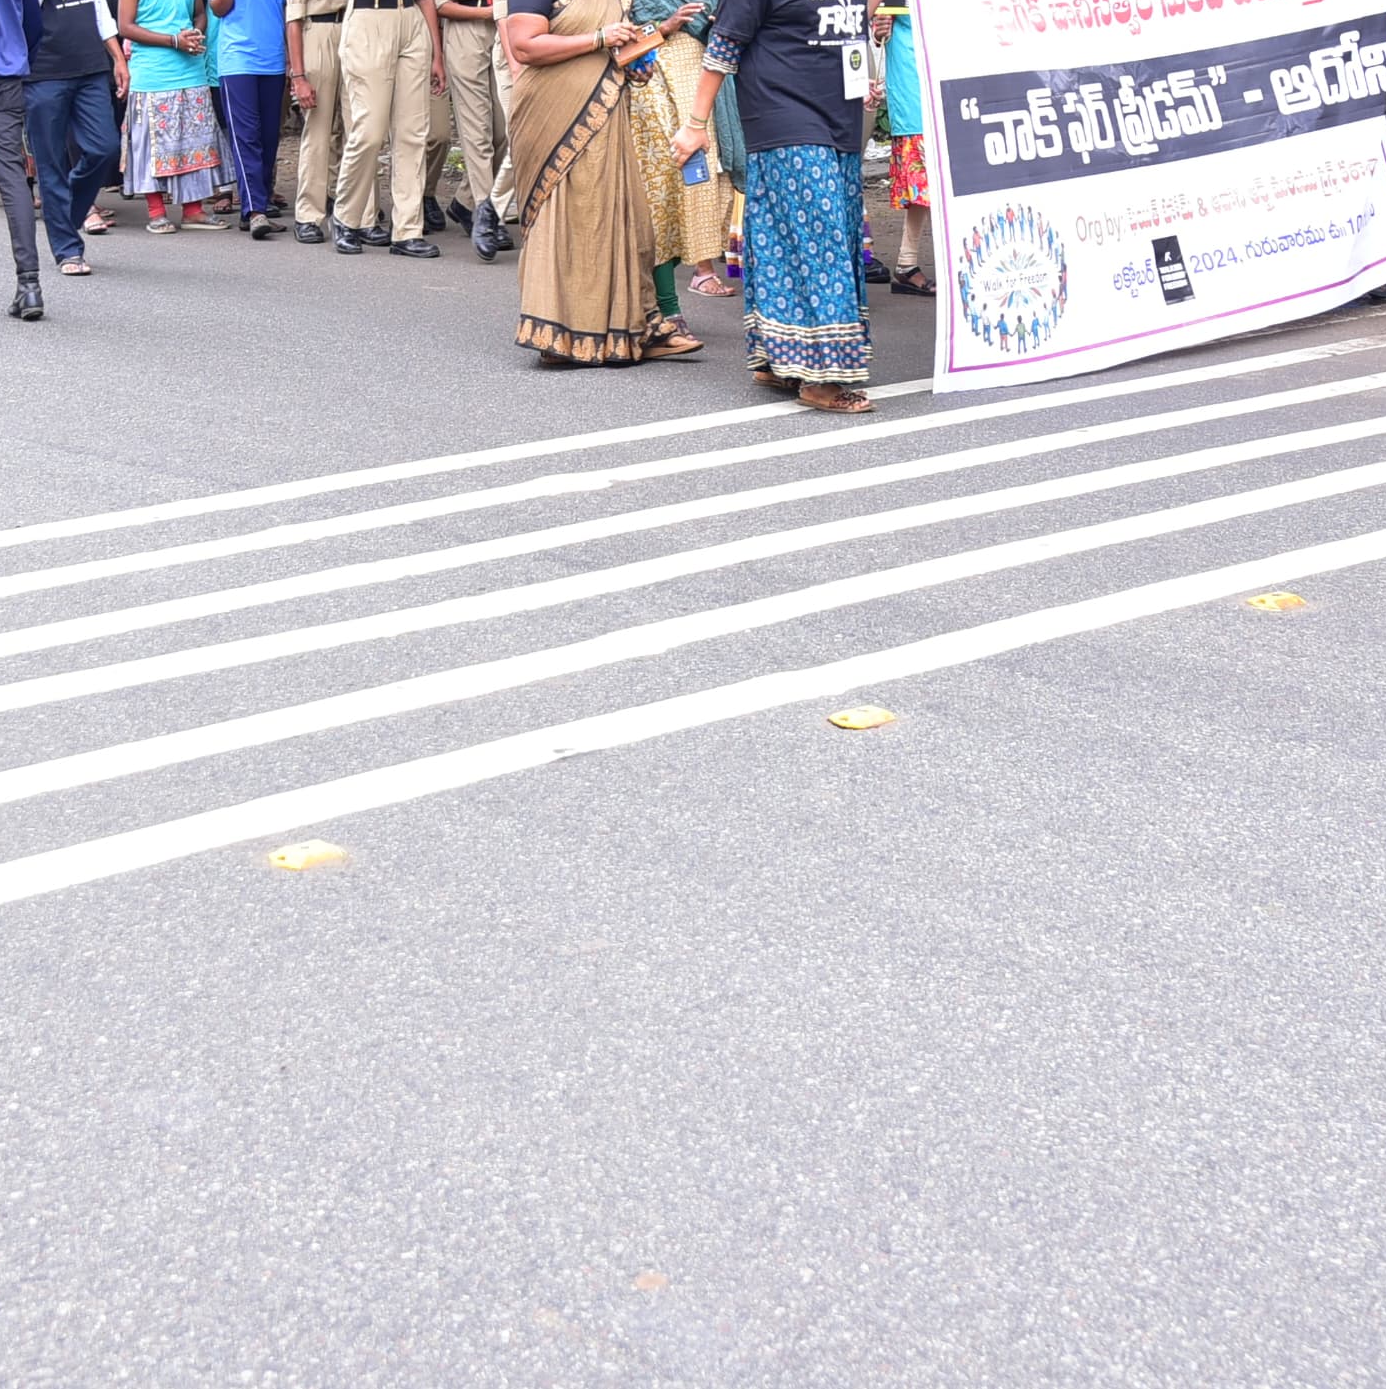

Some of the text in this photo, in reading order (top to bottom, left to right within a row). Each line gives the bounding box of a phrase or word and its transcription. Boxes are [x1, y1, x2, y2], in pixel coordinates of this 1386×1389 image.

[1076, 214, 1104, 246] Org
[1243, 225, 1326, 261] గురువారము
[1112, 258, 1155, 298] అక్టోబర్
